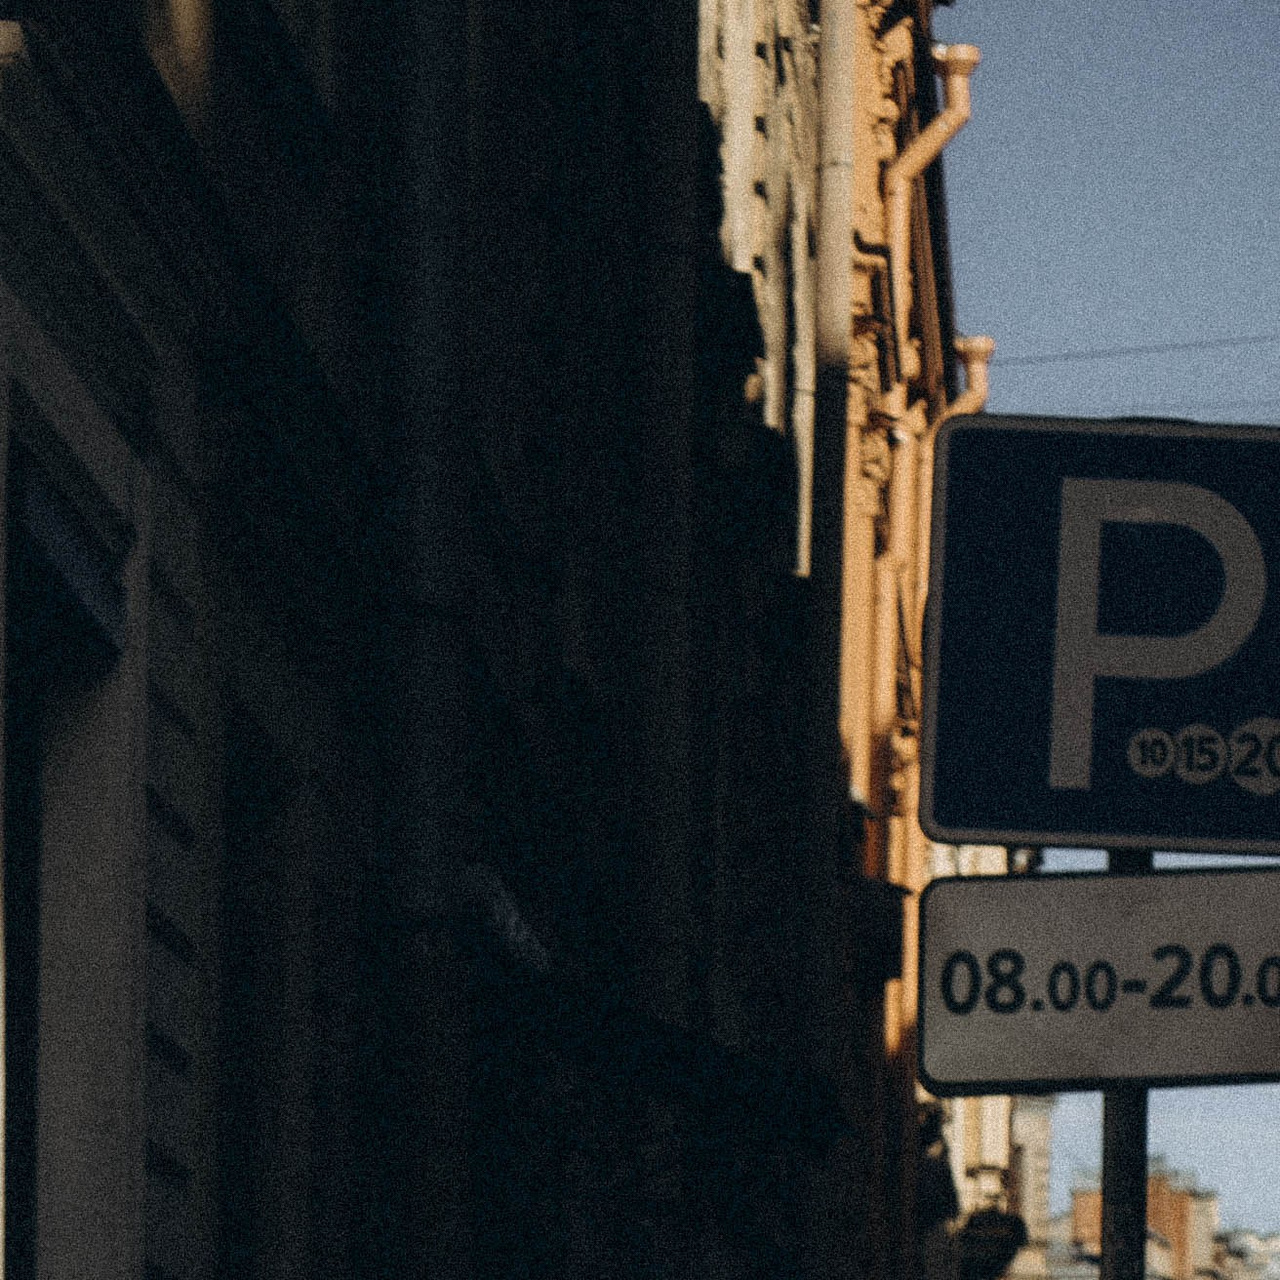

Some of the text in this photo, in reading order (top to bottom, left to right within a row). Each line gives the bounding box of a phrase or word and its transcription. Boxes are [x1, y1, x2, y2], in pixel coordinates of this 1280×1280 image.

[1049, 477, 1267, 788] P
[1136, 738, 1168, 767] 10
[1182, 735, 1219, 772] 15
